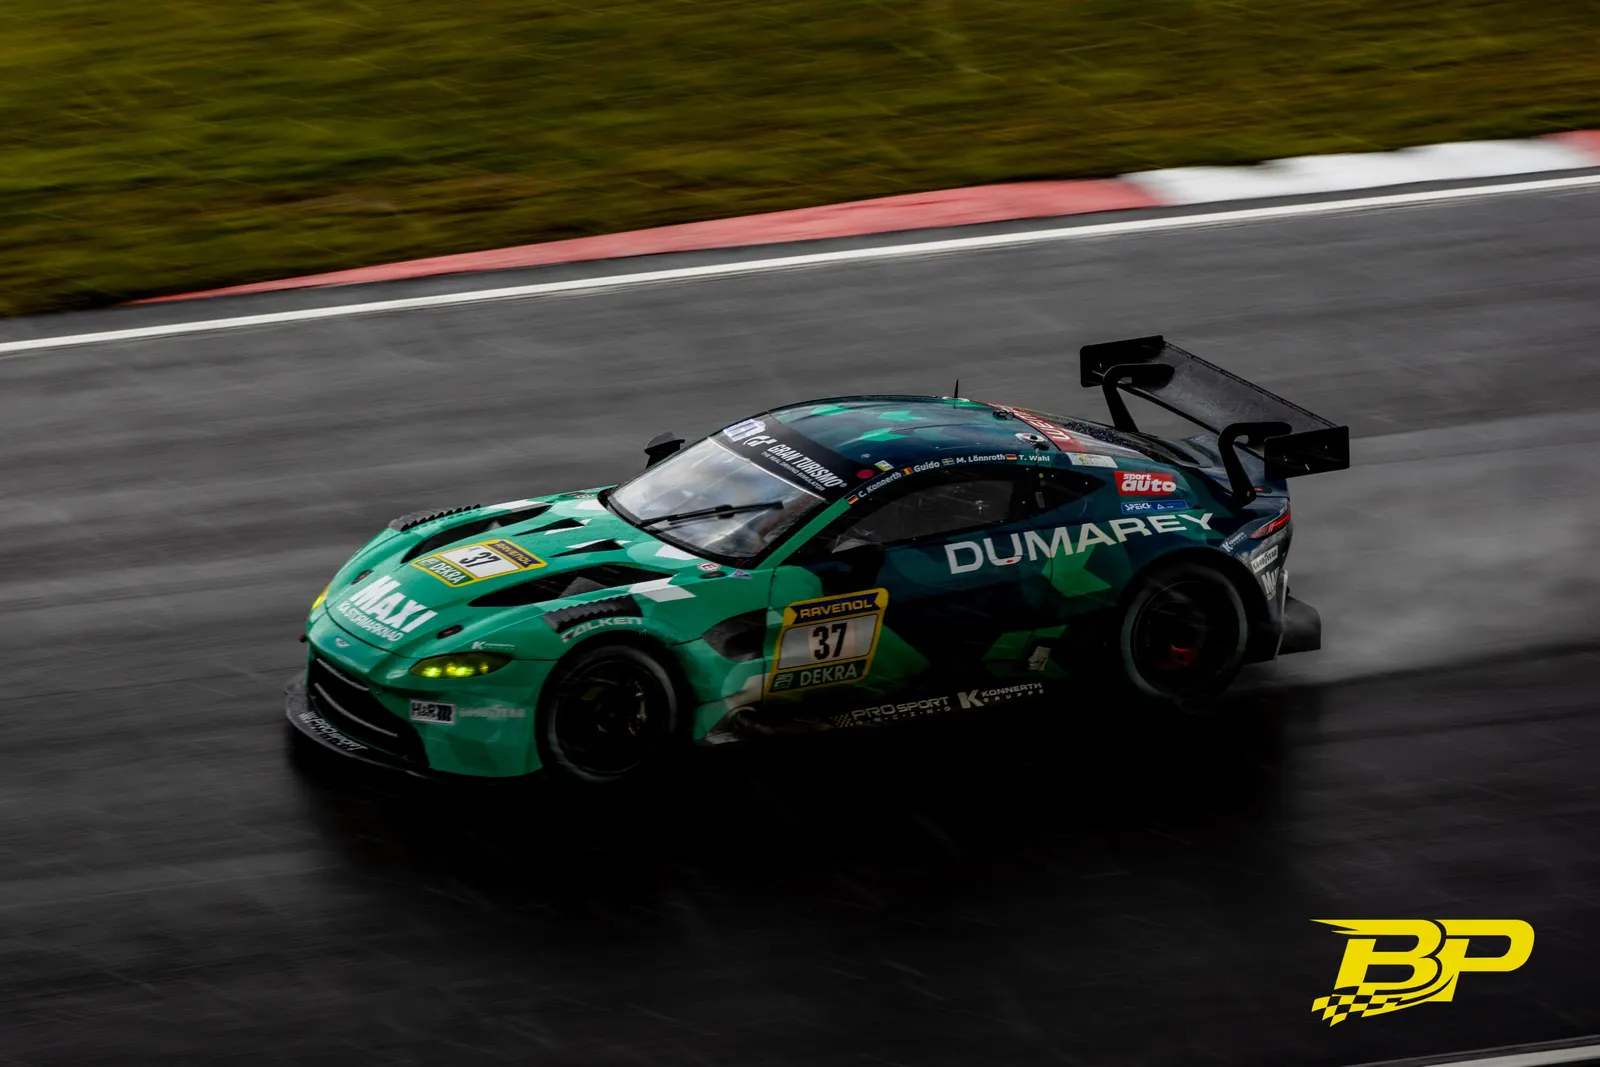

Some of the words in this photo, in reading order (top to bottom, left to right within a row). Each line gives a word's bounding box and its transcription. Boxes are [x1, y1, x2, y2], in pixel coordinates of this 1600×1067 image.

[768, 444, 803, 461] GRAN
[968, 453, 1006, 463] Lönnroth
[1028, 454, 1051, 462] Wahl
[913, 461, 940, 473] Guido
[1123, 473, 1152, 481] sport
[857, 490, 867, 498] C.
[867, 471, 902, 494] Konnerth
[1121, 479, 1177, 492] auto
[944, 512, 1214, 575] DUMAREY
[459, 551, 501, 568] 37
[429, 562, 467, 584] DEKRA
[349, 576, 438, 633] MAXI
[800, 599, 873, 619] RAVENOL
[561, 616, 643, 643] FALKEN
[812, 622, 848, 660] 37
[800, 664, 858, 686] DEKRA
